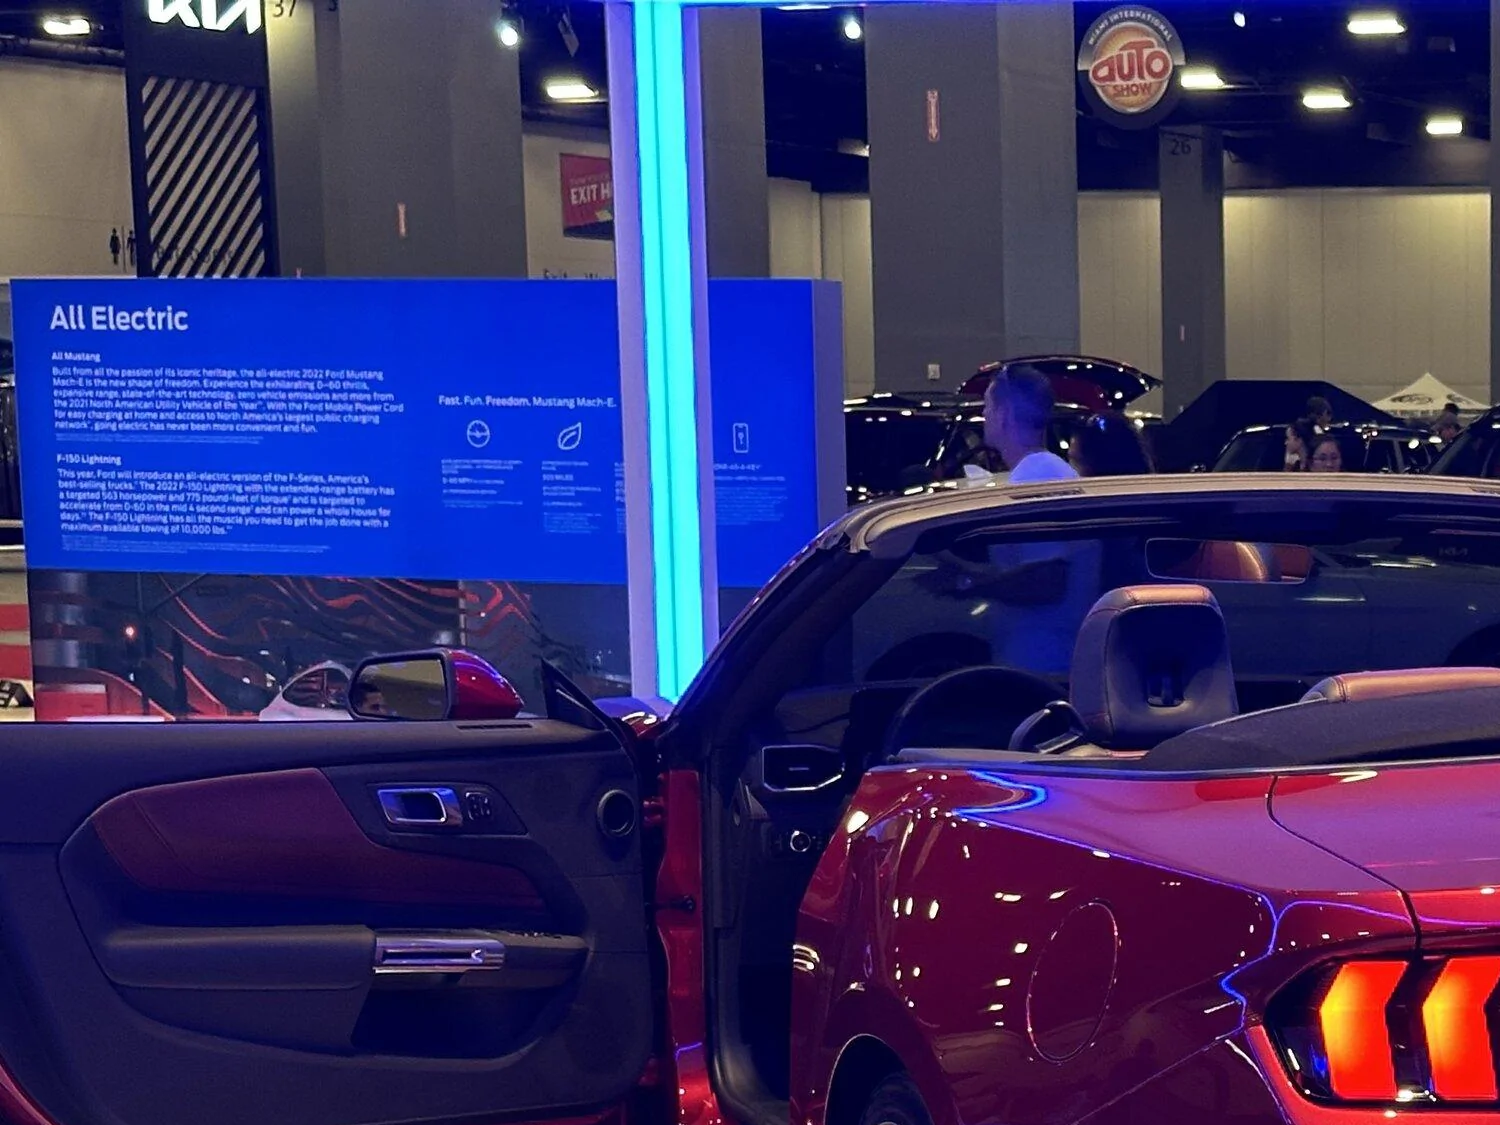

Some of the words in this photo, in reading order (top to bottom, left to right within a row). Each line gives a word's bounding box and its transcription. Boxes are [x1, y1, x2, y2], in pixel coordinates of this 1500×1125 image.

[1108, 10, 1172, 42] INTERNATIONAL
[1112, 82, 1152, 98] SHOW
[1171, 138, 1192, 155] 26
[570, 183, 598, 205] EXIT
[50, 304, 86, 330] All
[91, 304, 189, 331] Electric
[52, 352, 63, 361] All
[64, 352, 100, 363] Mustang
[57, 454, 80, 463] F-150
[81, 454, 121, 465] Lightning
